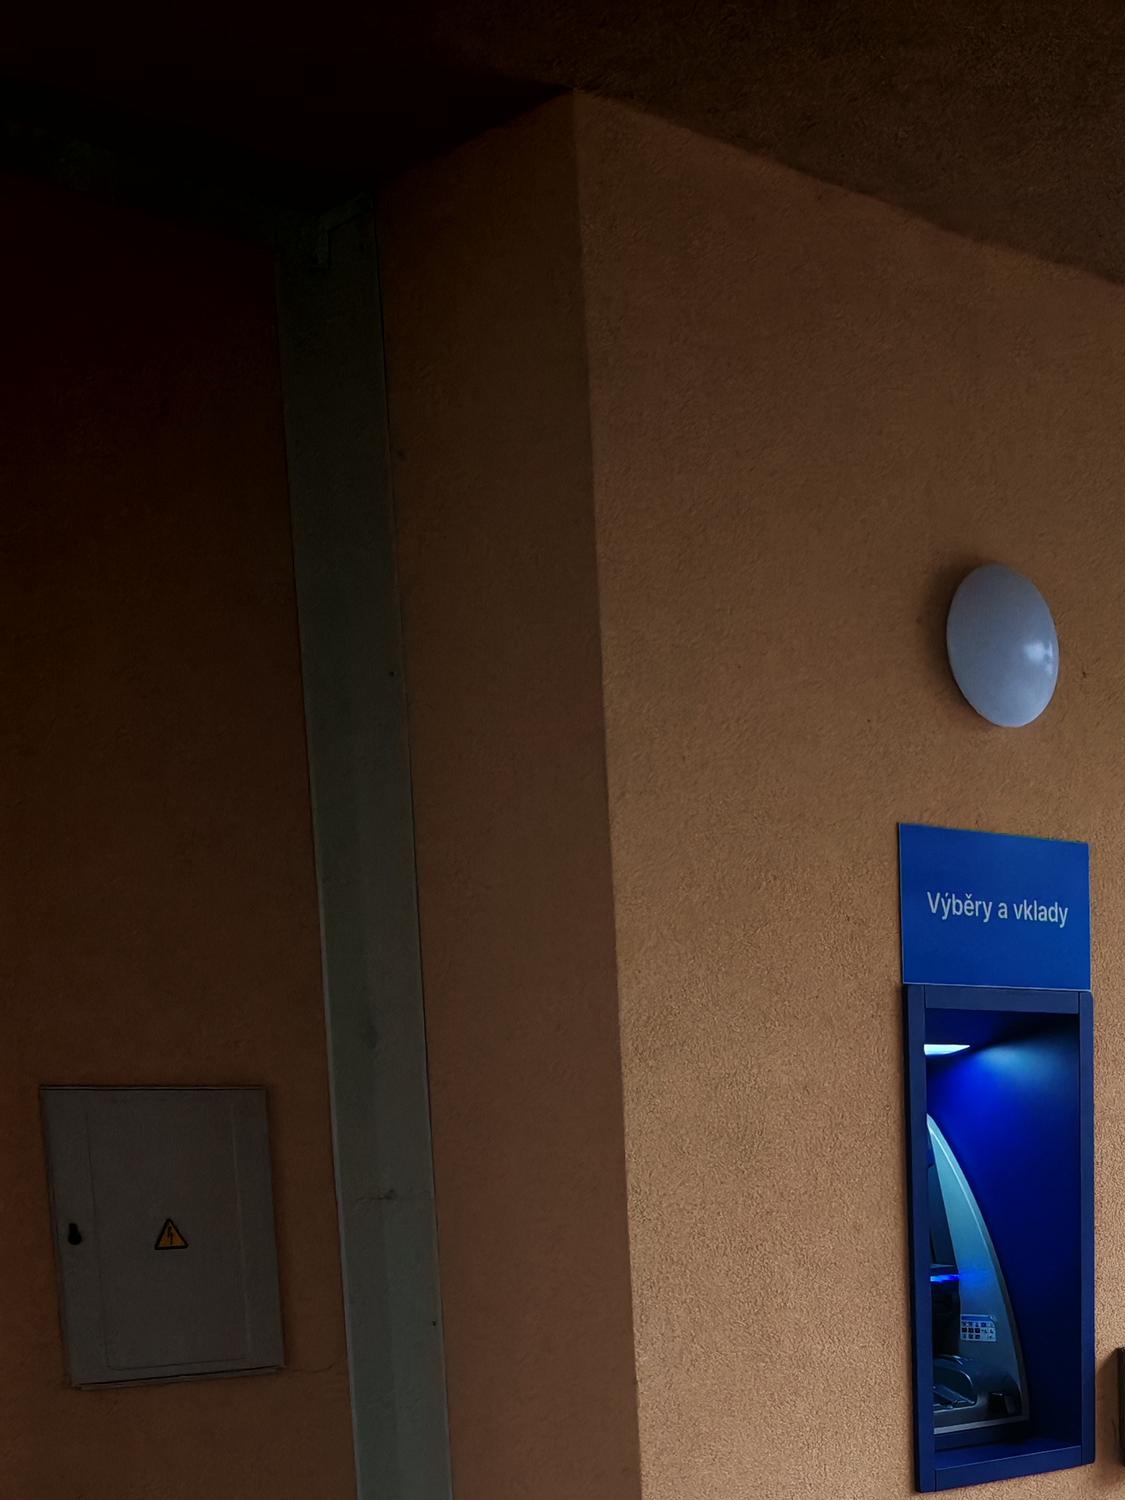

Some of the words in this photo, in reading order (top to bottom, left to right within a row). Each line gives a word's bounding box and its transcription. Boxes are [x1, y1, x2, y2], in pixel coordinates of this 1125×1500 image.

[927, 891, 993, 923] Výběry
[998, 902, 1008, 919] a
[1013, 899, 1069, 929] vklady
